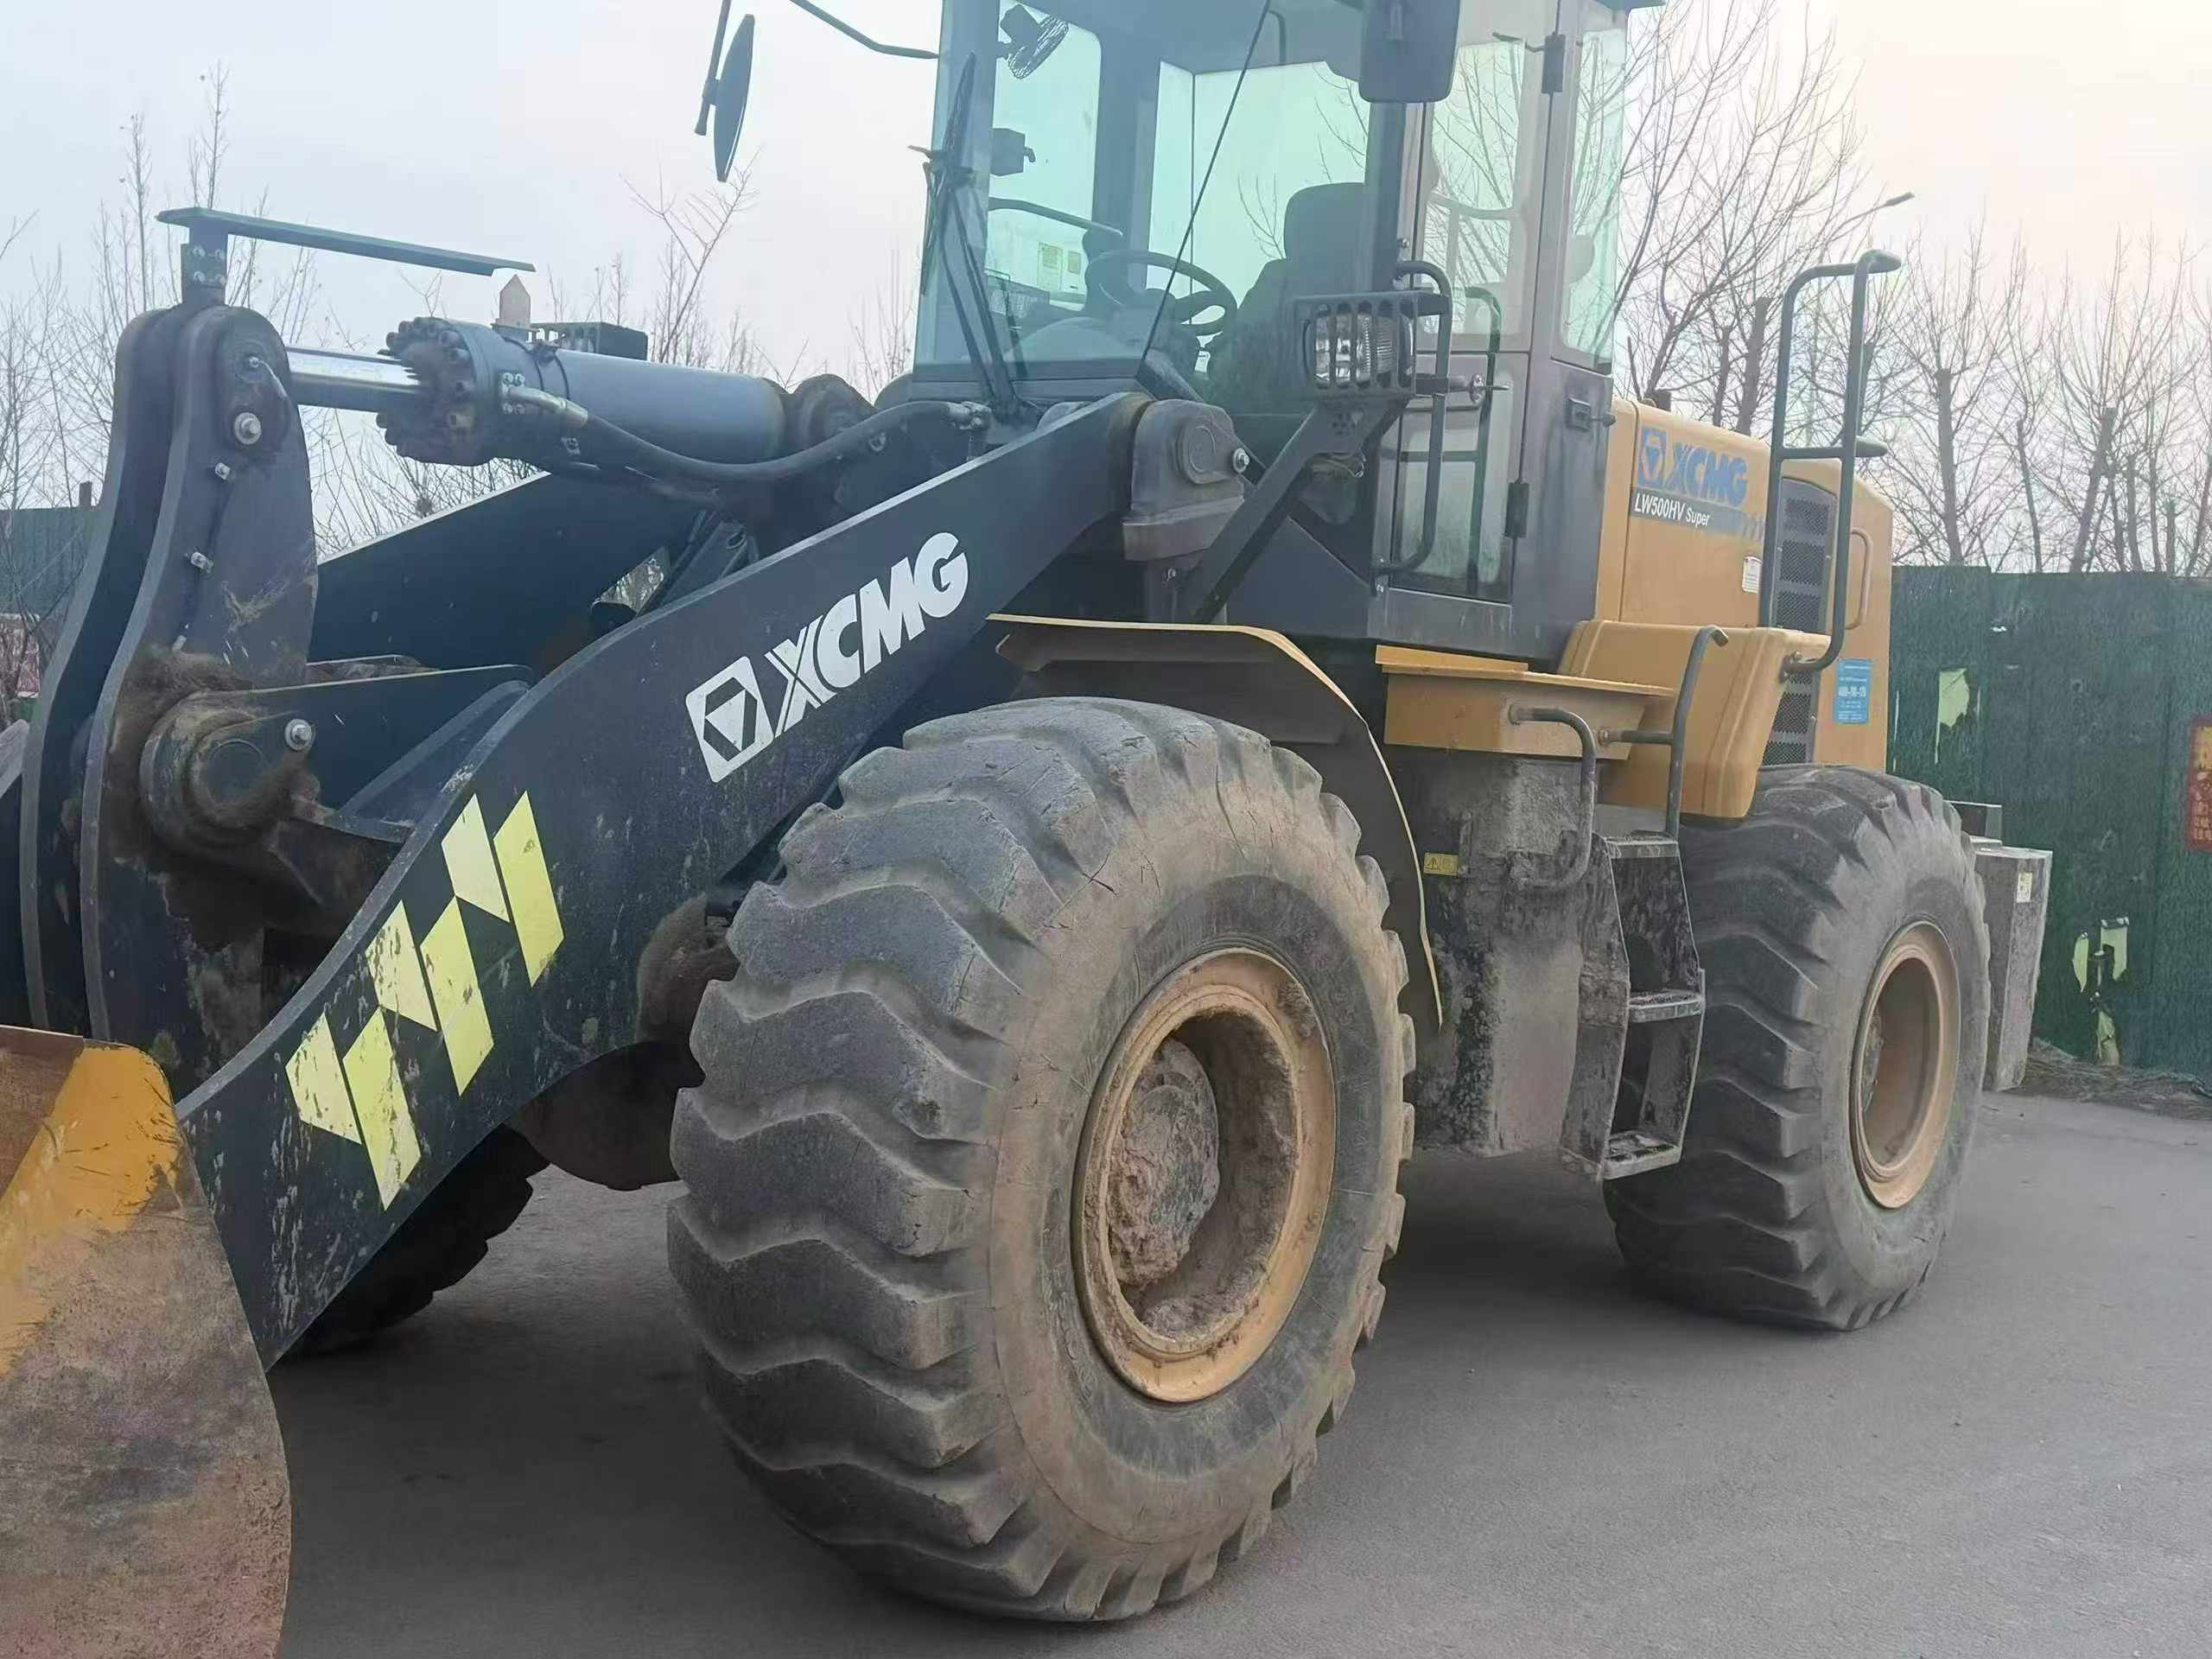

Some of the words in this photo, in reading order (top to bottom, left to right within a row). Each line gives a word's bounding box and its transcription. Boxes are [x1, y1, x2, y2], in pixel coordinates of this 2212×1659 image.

[1662, 442, 1748, 508] XCMG
[1634, 493, 1686, 520] LW500HV
[1685, 507, 1710, 529] Super
[764, 531, 969, 739] XCMG
